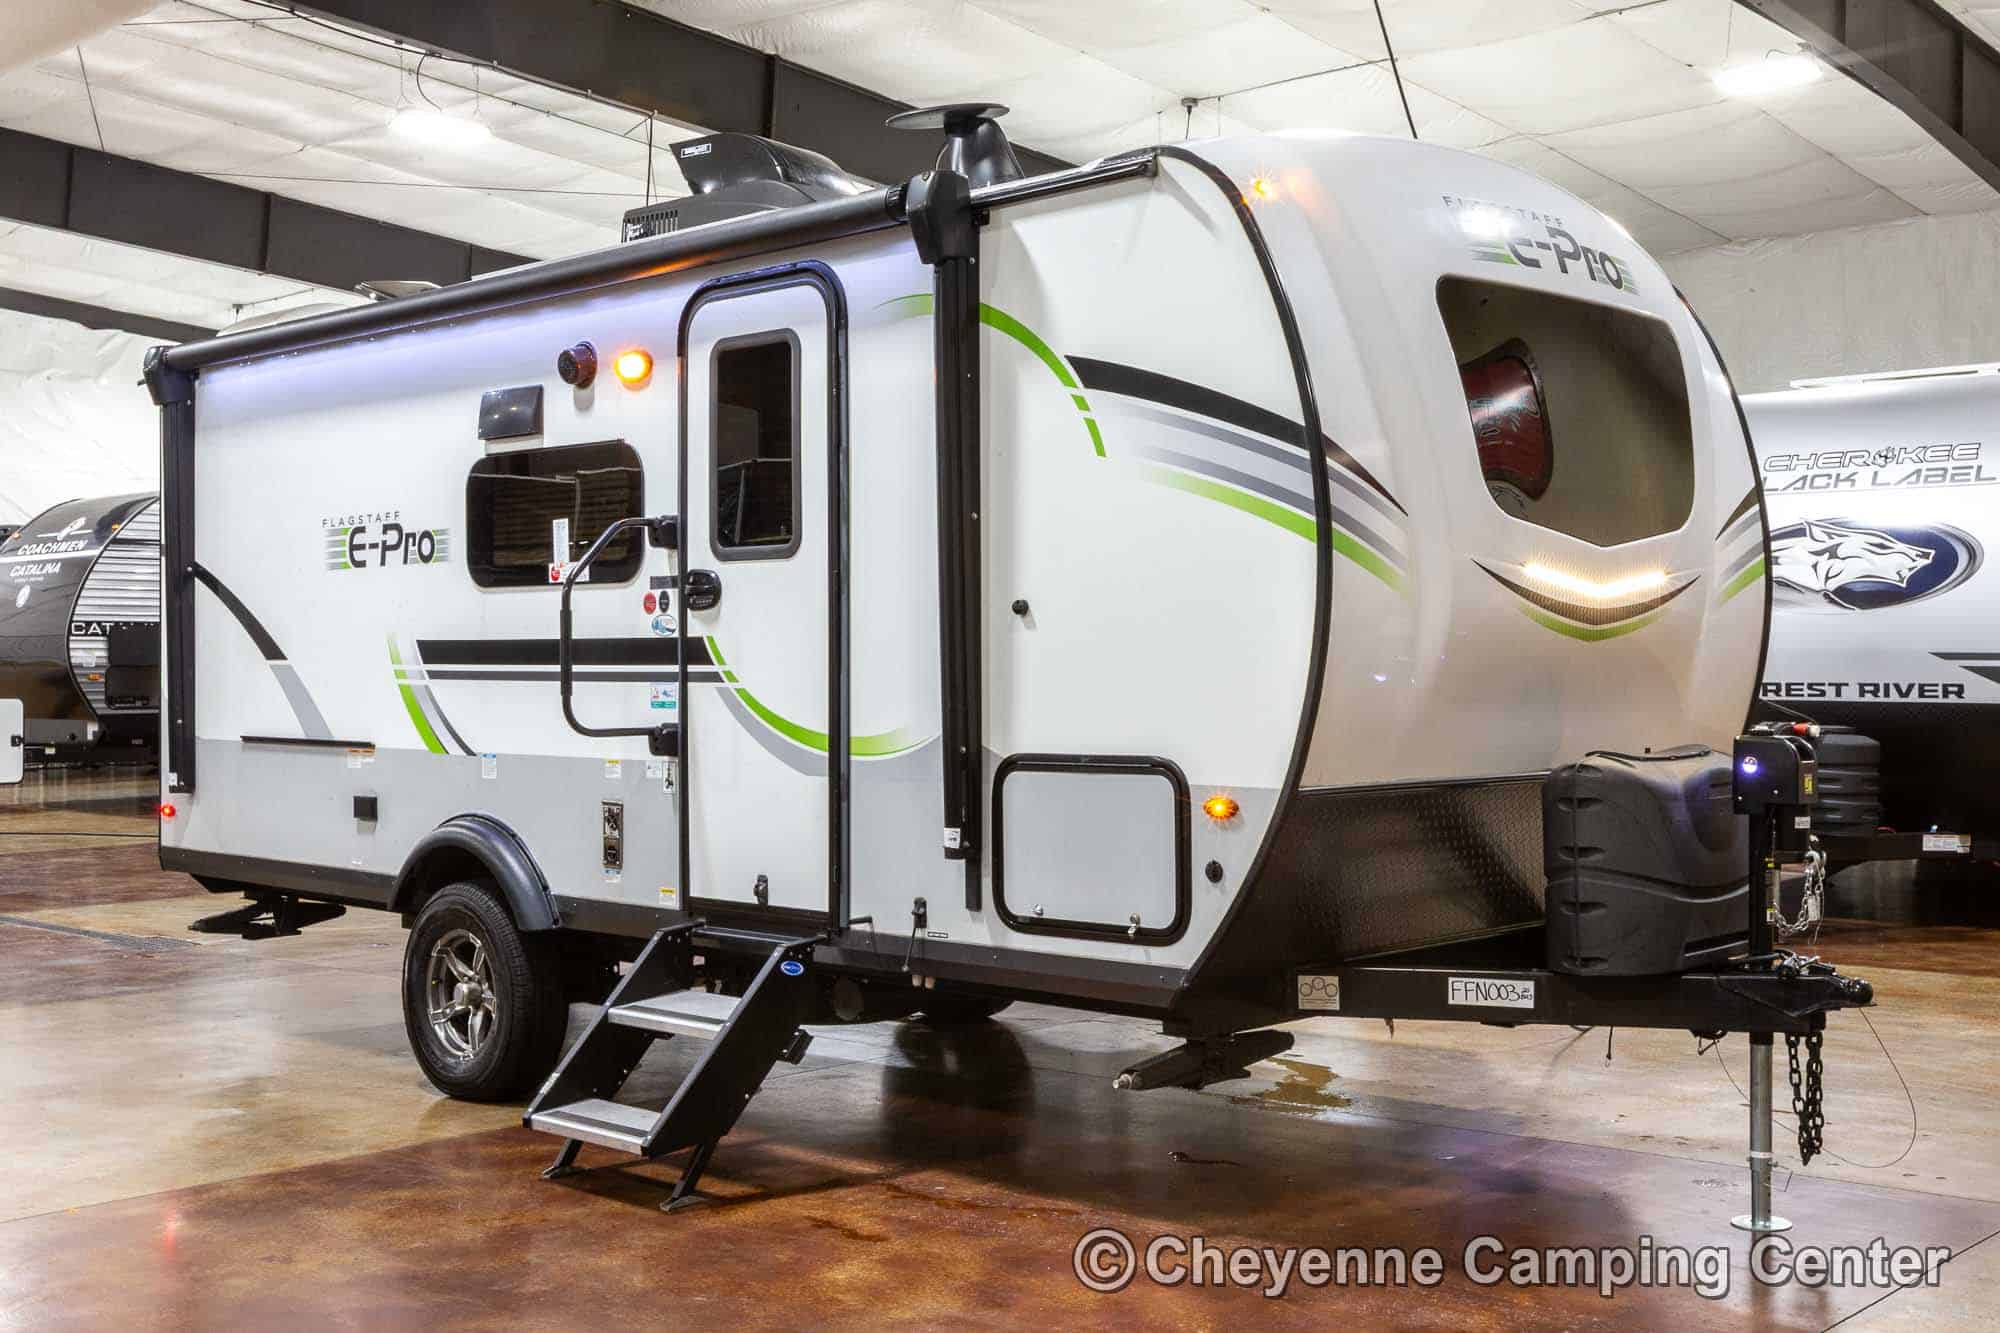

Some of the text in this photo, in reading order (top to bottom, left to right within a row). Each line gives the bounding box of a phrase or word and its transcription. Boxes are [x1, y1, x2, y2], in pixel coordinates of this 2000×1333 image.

[1761, 465, 1998, 492] LACK LABEL
[321, 511, 401, 528] FLAGSTAFF
[17, 539, 89, 556] COACHMEN
[348, 522, 436, 568] E-Pro
[9, 561, 62, 577] CATALINA
[1761, 682, 1966, 699] REST RIVER
[1451, 980, 1520, 1002] FFN003
